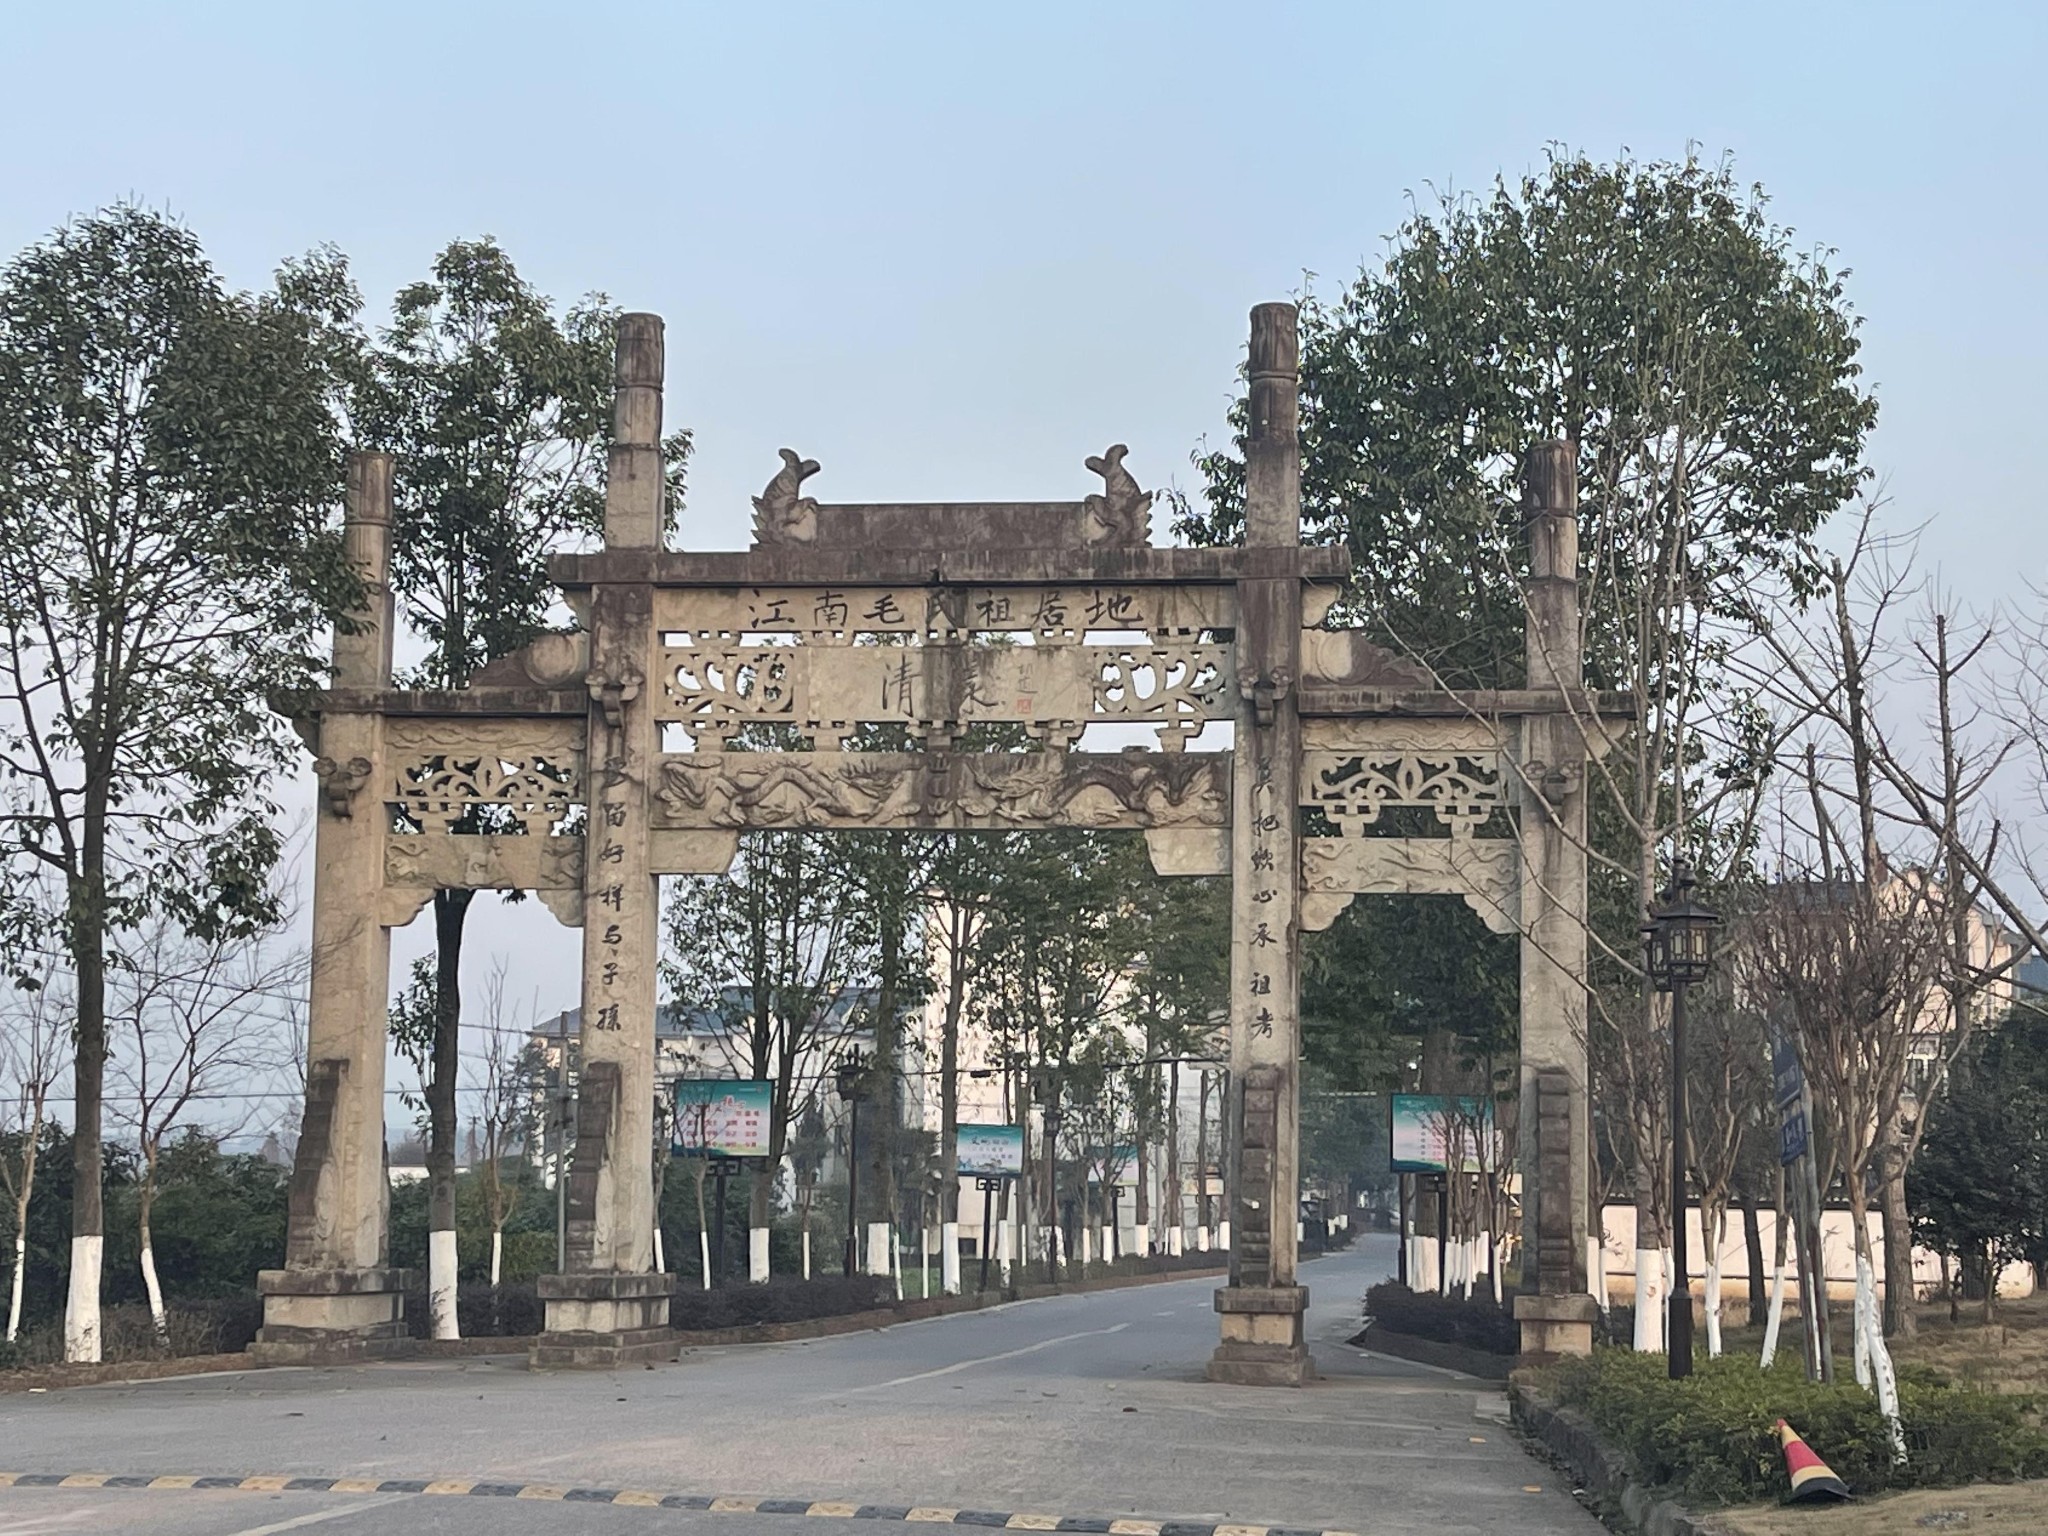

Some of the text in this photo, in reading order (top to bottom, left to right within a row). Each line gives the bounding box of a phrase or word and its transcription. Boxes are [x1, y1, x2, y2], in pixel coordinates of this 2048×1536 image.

[749, 588, 1143, 628] 江南毛氏祖居地
